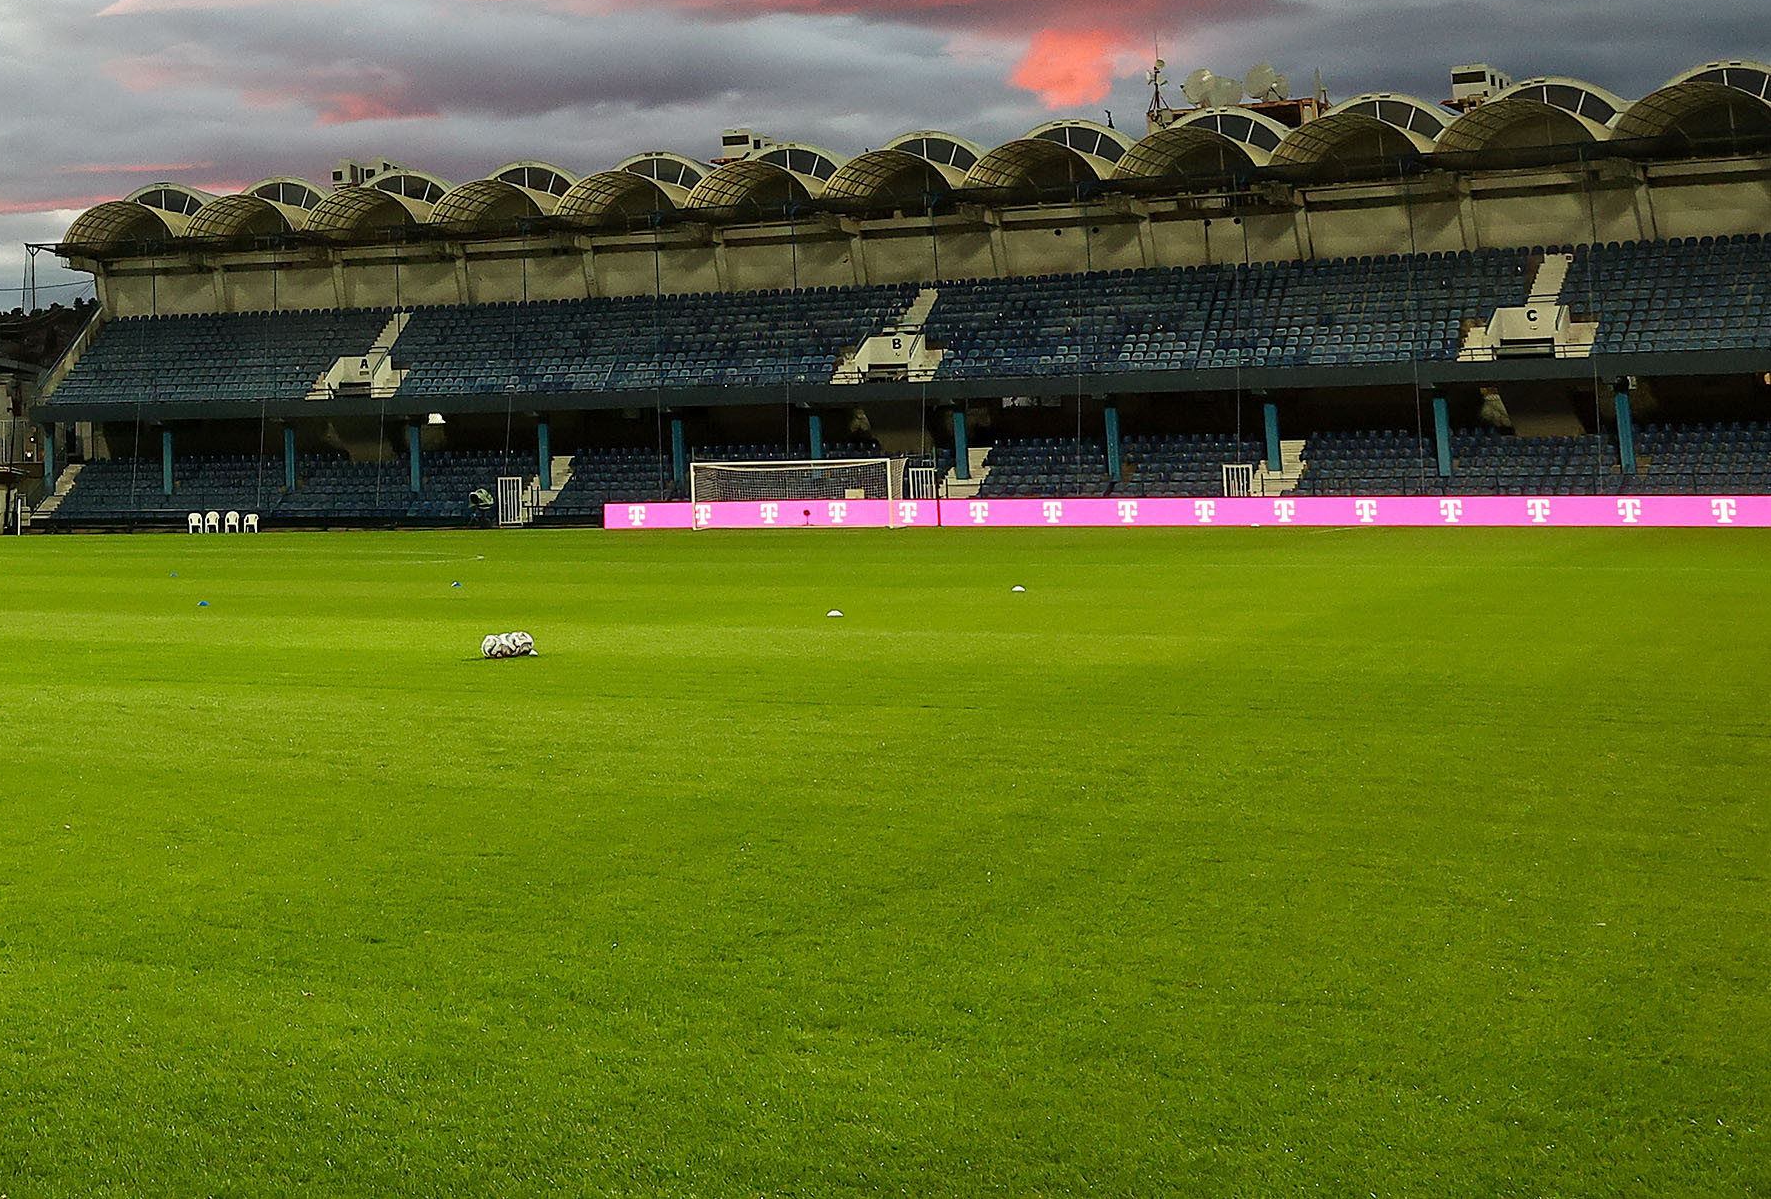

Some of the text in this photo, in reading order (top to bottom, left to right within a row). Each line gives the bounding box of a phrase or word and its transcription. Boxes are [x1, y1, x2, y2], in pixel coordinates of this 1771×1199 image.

[1527, 309, 1538, 322] C
[892, 338, 902, 349] B
[360, 359, 369, 369] A
[629, 506, 646, 526] T
[761, 503, 778, 524] T
[828, 502, 847, 523] T
[899, 502, 917, 523] T
[970, 502, 988, 523] T
[1043, 502, 1062, 523] T
[1118, 501, 1138, 522] T
[1195, 501, 1215, 522] T
[1274, 500, 1295, 522] T
[1356, 500, 1377, 522] T
[1440, 500, 1462, 522] T
[1527, 499, 1550, 522] T
[1618, 499, 1641, 522] T
[1712, 499, 1736, 523] T
